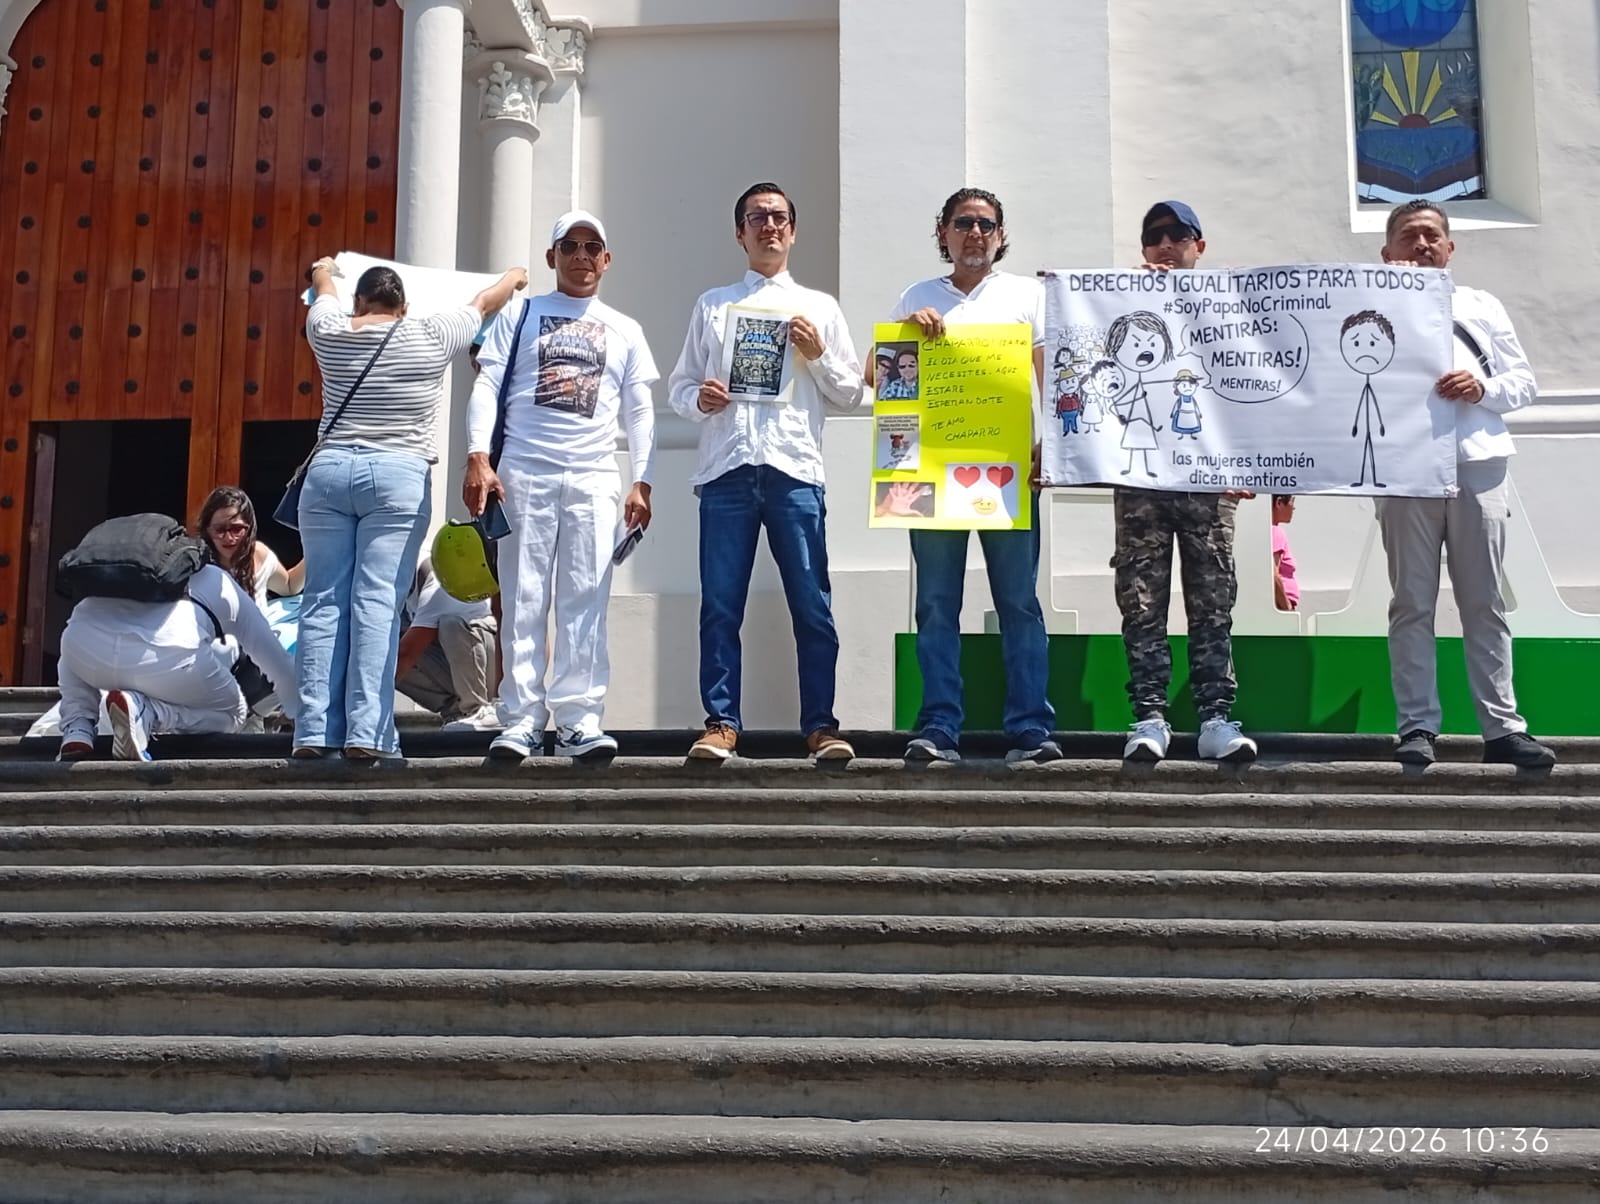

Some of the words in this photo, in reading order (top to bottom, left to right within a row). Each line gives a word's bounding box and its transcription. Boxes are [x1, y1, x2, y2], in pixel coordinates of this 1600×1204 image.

[1070, 273, 1167, 292] DERECHOS
[1173, 270, 1301, 293] IGUALITARIOS
[1307, 269, 1357, 288] PARA
[1363, 269, 1425, 291] TODOS
[1163, 292, 1331, 320] #SoyPapaNoCriminal
[1211, 346, 1302, 368] MENTIRAS!
[1220, 377, 1281, 393] MENTIRAS!
[931, 420, 944, 432] TE
[946, 416, 965, 428] AMO
[1172, 450, 1192, 466] las
[1196, 453, 1253, 471] mujeres
[1255, 451, 1315, 468] también
[1189, 469, 1227, 485] dicen
[1232, 471, 1297, 487] mentiras
